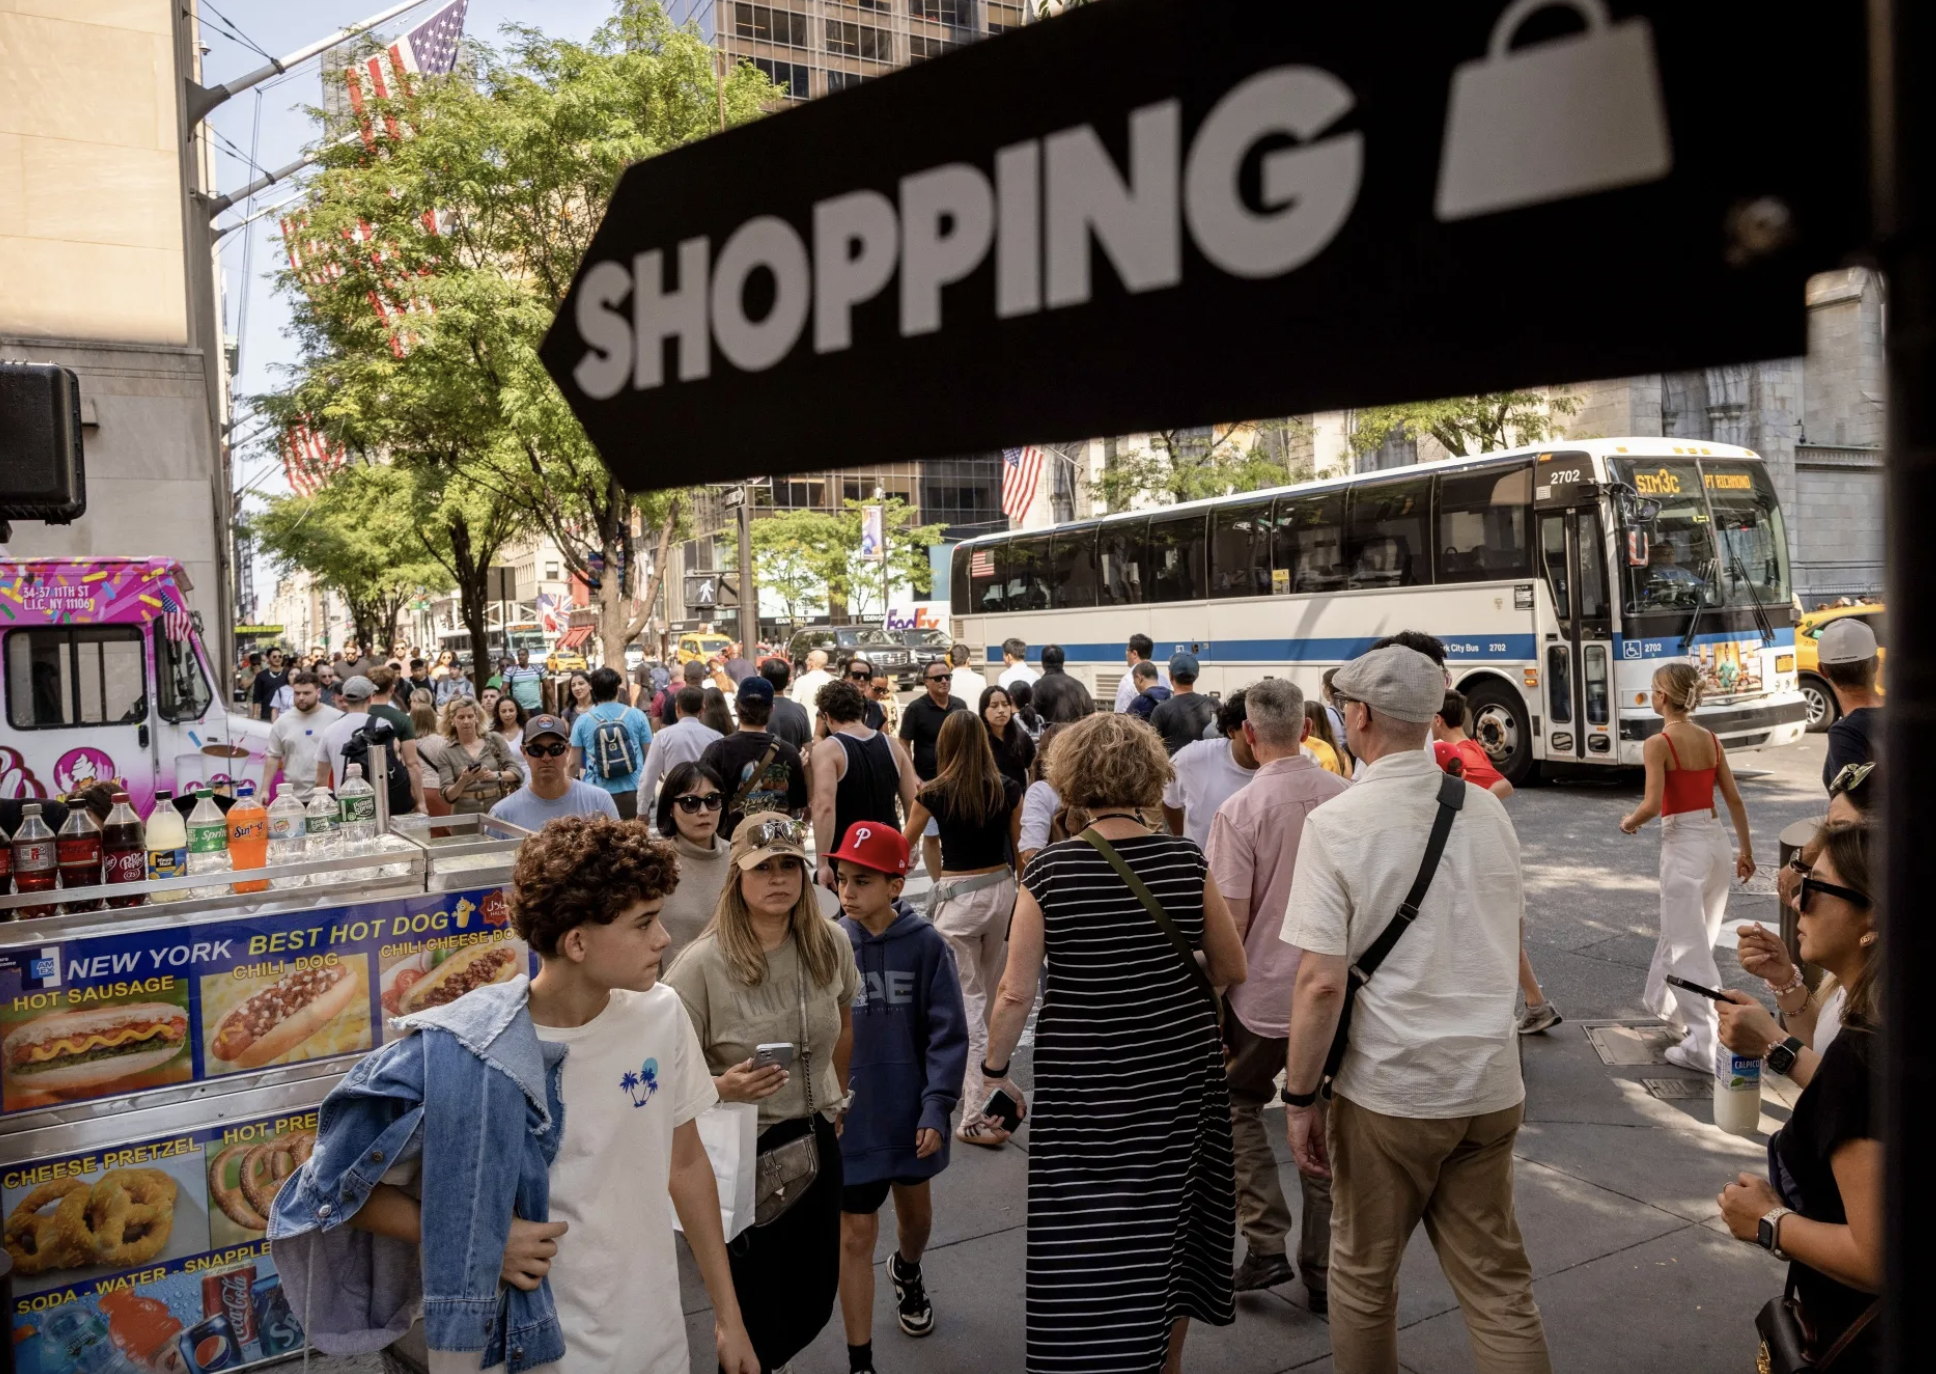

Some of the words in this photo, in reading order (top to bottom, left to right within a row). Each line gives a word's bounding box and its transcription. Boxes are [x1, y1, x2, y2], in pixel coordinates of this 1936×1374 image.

[573, 64, 1365, 400] SHOPPING
[1551, 469, 1580, 485] 2702
[1635, 468, 1680, 493] SIM3C
[1715, 475, 1751, 489] RICHMOND
[23, 587, 50, 598] 34-37
[54, 585, 74, 597] 11TH
[77, 585, 90, 597] ST
[50, 598, 62, 609] NY
[66, 598, 90, 609] 11106
[1451, 643, 1464, 654] City
[1465, 643, 1479, 652] Bus
[1489, 643, 1506, 652] 2702
[1645, 643, 1662, 653] 2702
[201, 828, 227, 842] Sprit
[853, 827, 871, 849] P
[130, 852, 140, 860] Dr
[67, 951, 142, 980] NEW
[149, 939, 233, 969] YORK
[248, 927, 323, 956] BEST
[329, 919, 386, 944] HOT
[392, 911, 449, 936] DOG
[381, 940, 422, 958] CHILI
[426, 931, 489, 951] CHEESE
[493, 927, 515, 942] DO
[36, 960, 54, 970] AM
[39, 967, 54, 976] EX
[232, 959, 285, 980] CHILI
[295, 952, 338, 971] DOG
[13, 991, 61, 1012] HOT
[68, 975, 175, 1004] SAUSAGE
[1734, 1060, 1760, 1070] CALPICO
[223, 1123, 268, 1146] HOT
[275, 1112, 318, 1134] PRE
[4, 1155, 98, 1190] CHEESE
[103, 1136, 202, 1170] PRETZEL
[17, 1289, 79, 1316] SODA
[96, 1267, 167, 1296] WATER
[184, 1242, 272, 1274] SNAPPLE
